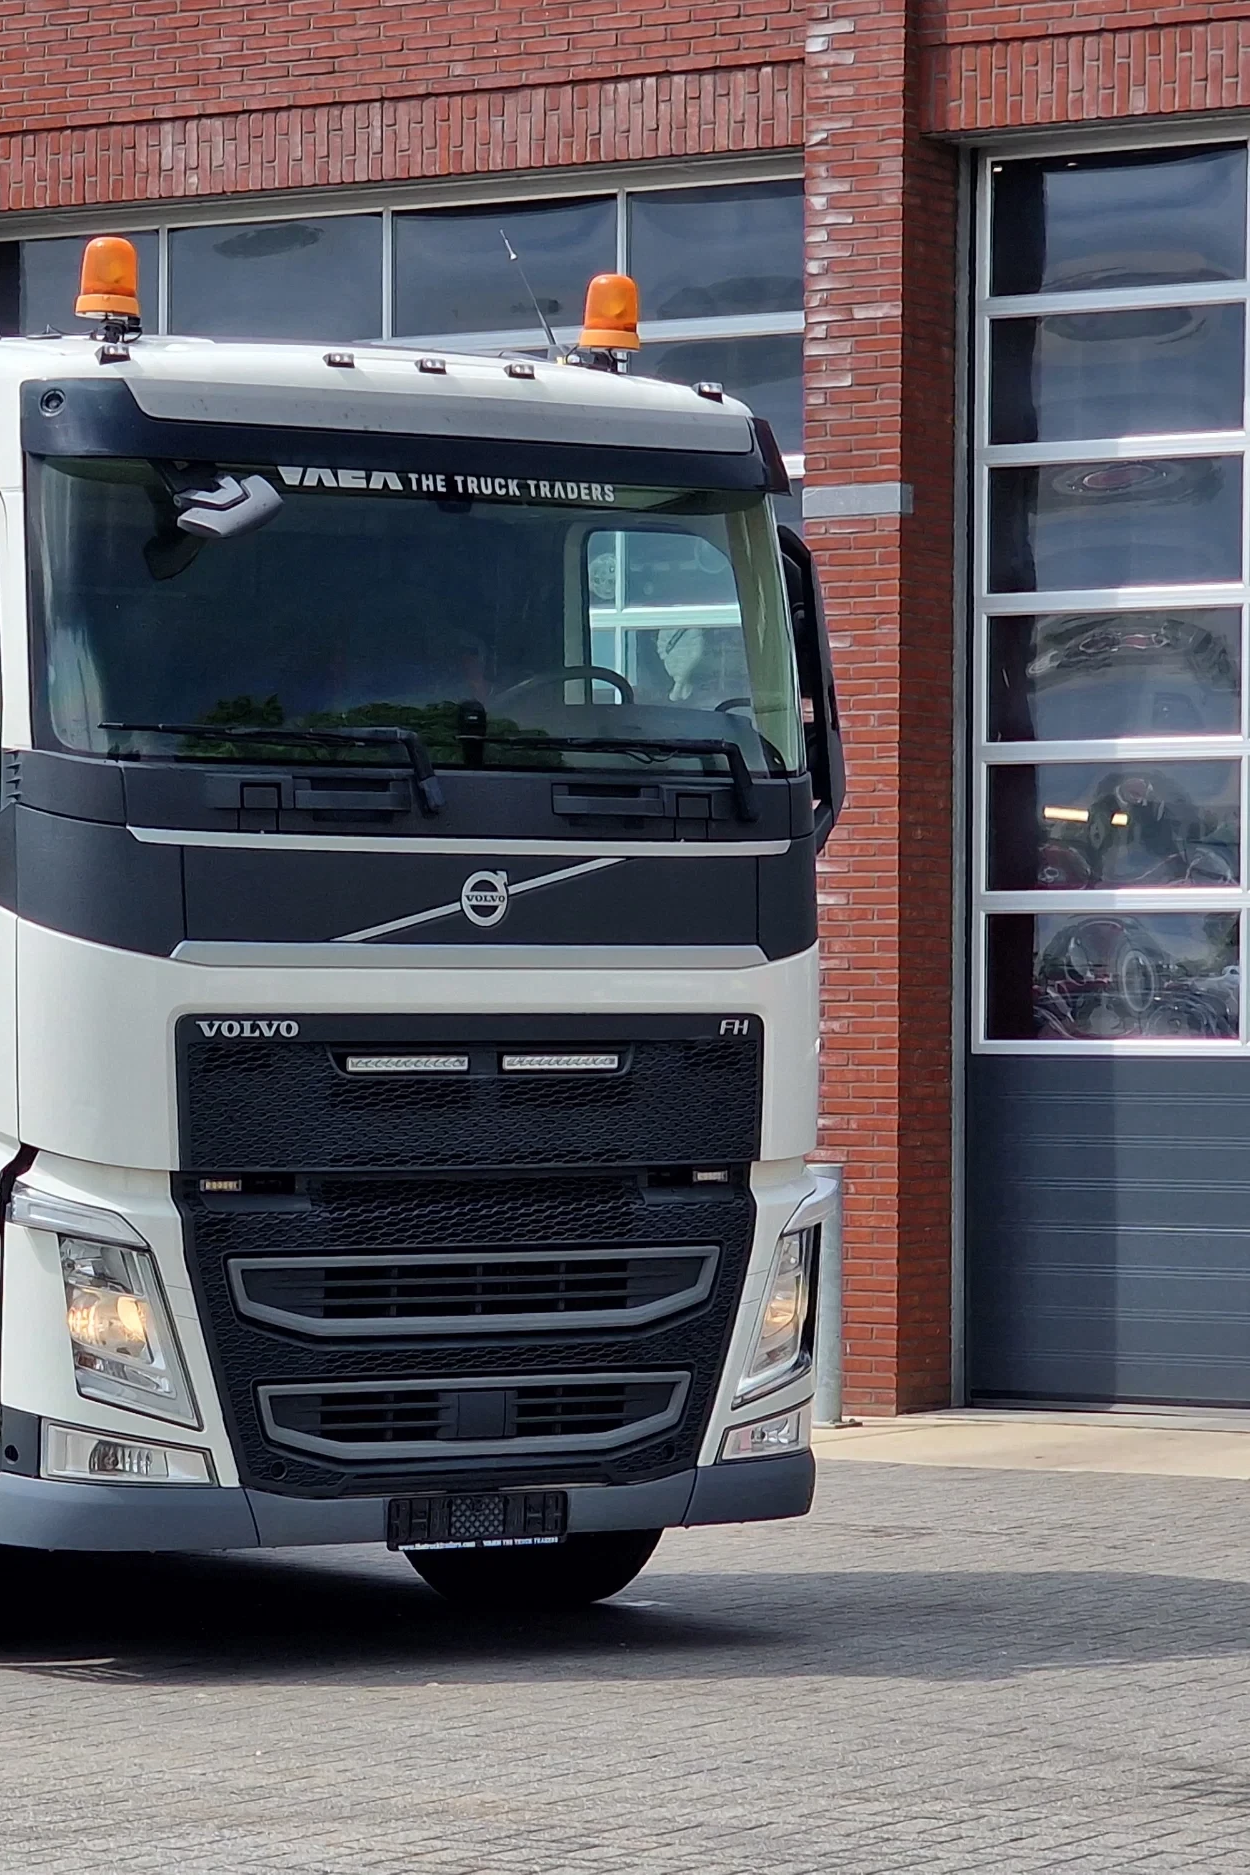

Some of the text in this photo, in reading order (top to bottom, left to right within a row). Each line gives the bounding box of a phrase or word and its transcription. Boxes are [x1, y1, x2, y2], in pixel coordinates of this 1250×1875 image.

[408, 473, 447, 493] THE
[454, 475, 521, 497] TRUCK
[526, 480, 615, 502] TRADERS
[464, 895, 506, 903] VOLVO
[195, 1020, 299, 1038] VOLVO
[720, 1019, 749, 1035] FH
